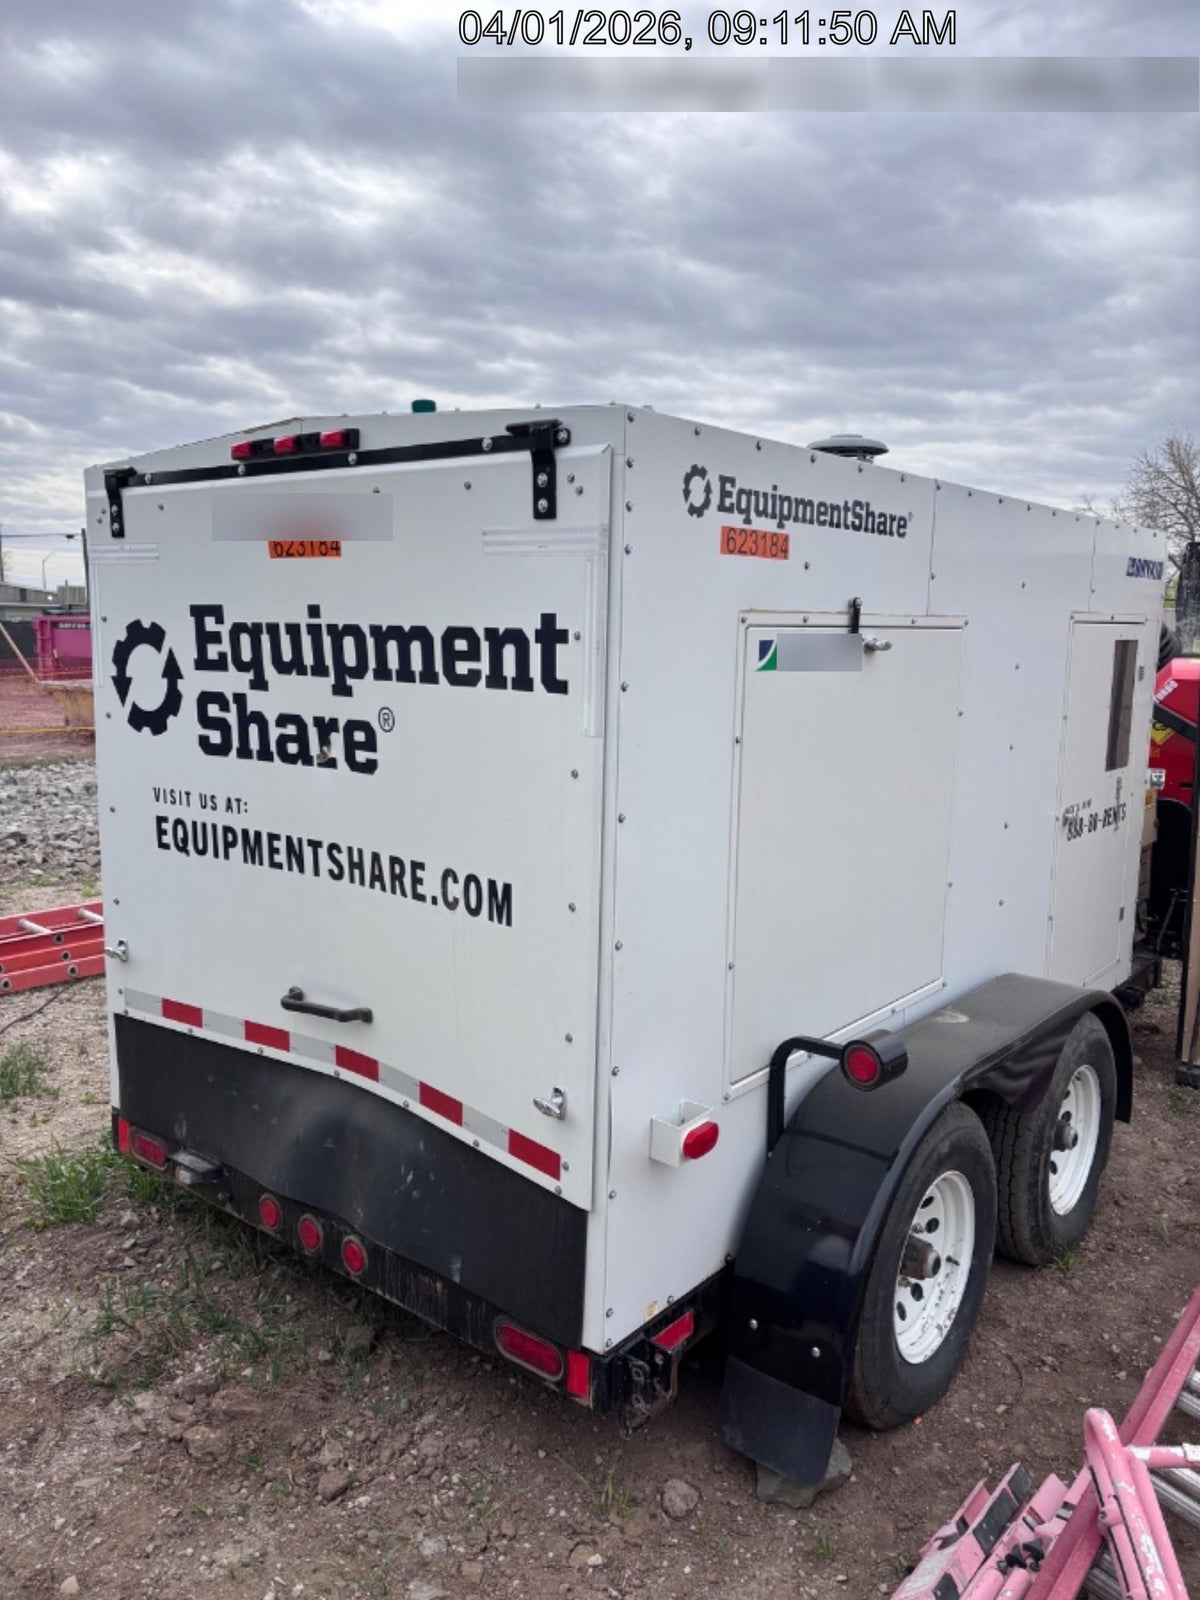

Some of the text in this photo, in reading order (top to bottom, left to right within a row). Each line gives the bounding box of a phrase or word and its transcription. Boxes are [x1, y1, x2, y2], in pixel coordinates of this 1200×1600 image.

[716, 474, 908, 538] EquipmentShare
[725, 527, 789, 558] 623184
[190, 604, 569, 697] Equipment
[153, 787, 249, 815] VISIT US AT:
[155, 815, 513, 927] EQUIPMENTSHARE.COM
